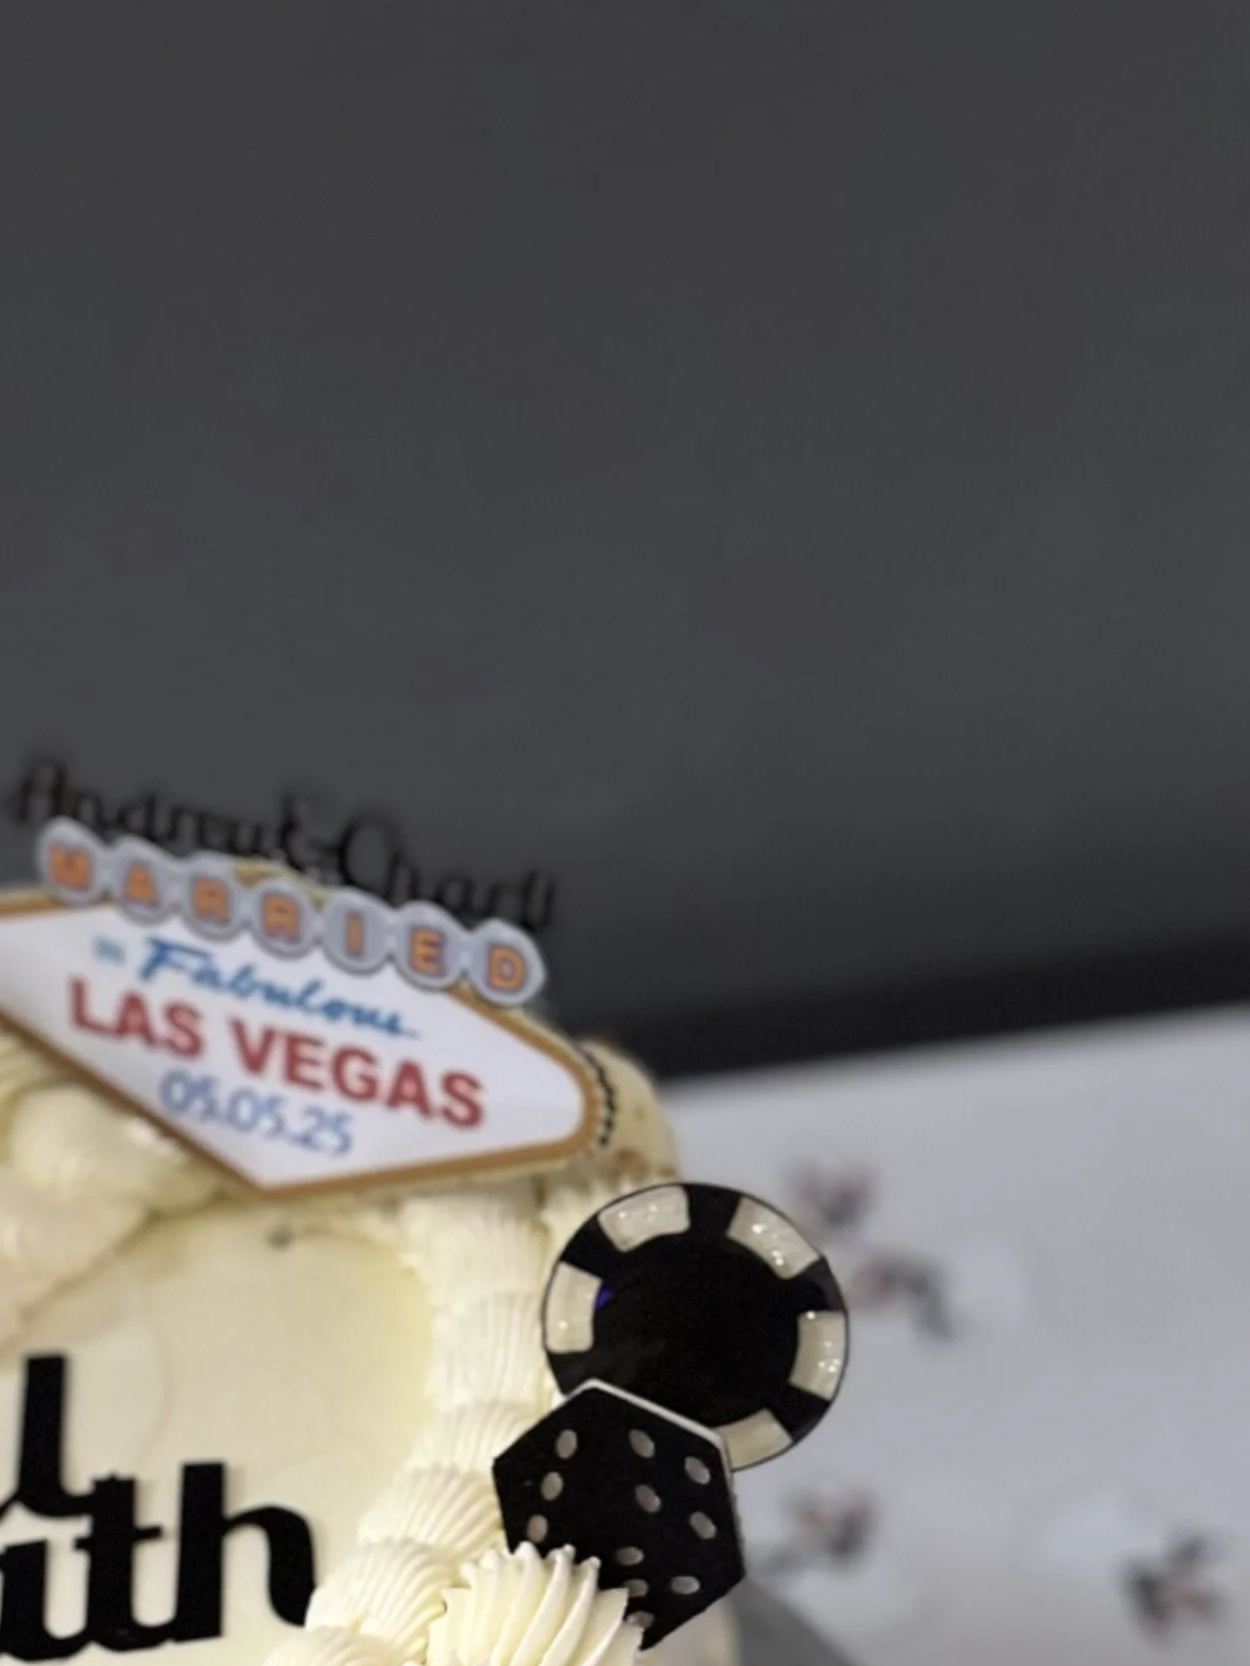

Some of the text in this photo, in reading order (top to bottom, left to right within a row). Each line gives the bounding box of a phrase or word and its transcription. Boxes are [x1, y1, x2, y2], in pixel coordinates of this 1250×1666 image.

[50, 842, 527, 992] MARRIED
[137, 934, 420, 1039] Fabulous
[70, 978, 486, 1132] LAS VEGAS
